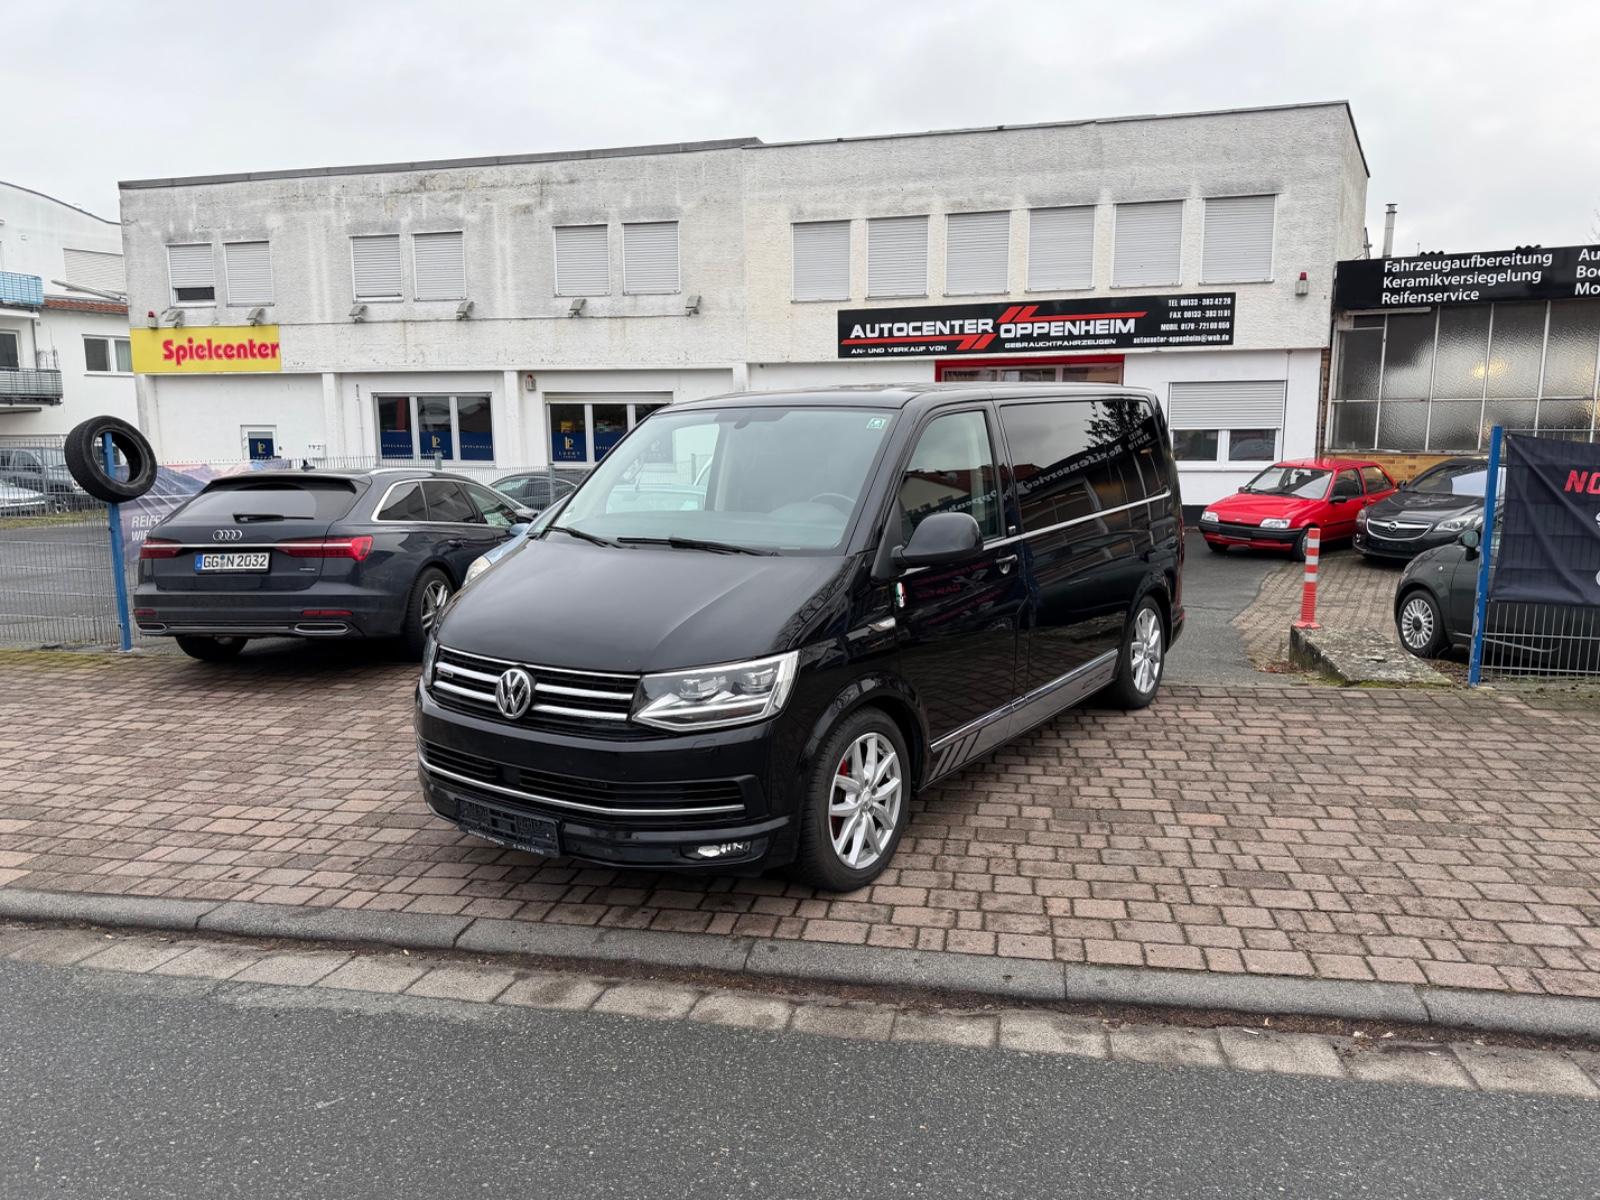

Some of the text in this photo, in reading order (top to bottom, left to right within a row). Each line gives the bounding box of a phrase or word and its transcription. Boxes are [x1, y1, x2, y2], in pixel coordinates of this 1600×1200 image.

[1384, 252, 1553, 273] Fahrzeugaufbereitung
[1576, 265, 1600, 278] Bo
[1383, 269, 1542, 289] Keramikversiegelung
[1381, 289, 1480, 304] Reifenservice
[1169, 311, 1182, 319] FAX
[850, 318, 1136, 338] AUTOCENTER OPPENHEIM
[162, 337, 279, 366] Spielcenter
[887, 345, 926, 353] VERKAUF
[1005, 339, 1117, 349] GEBRAUCHTFAHRZEUGEN
[131, 515, 163, 528] REIFE
[203, 554, 267, 568] GG N 2032
